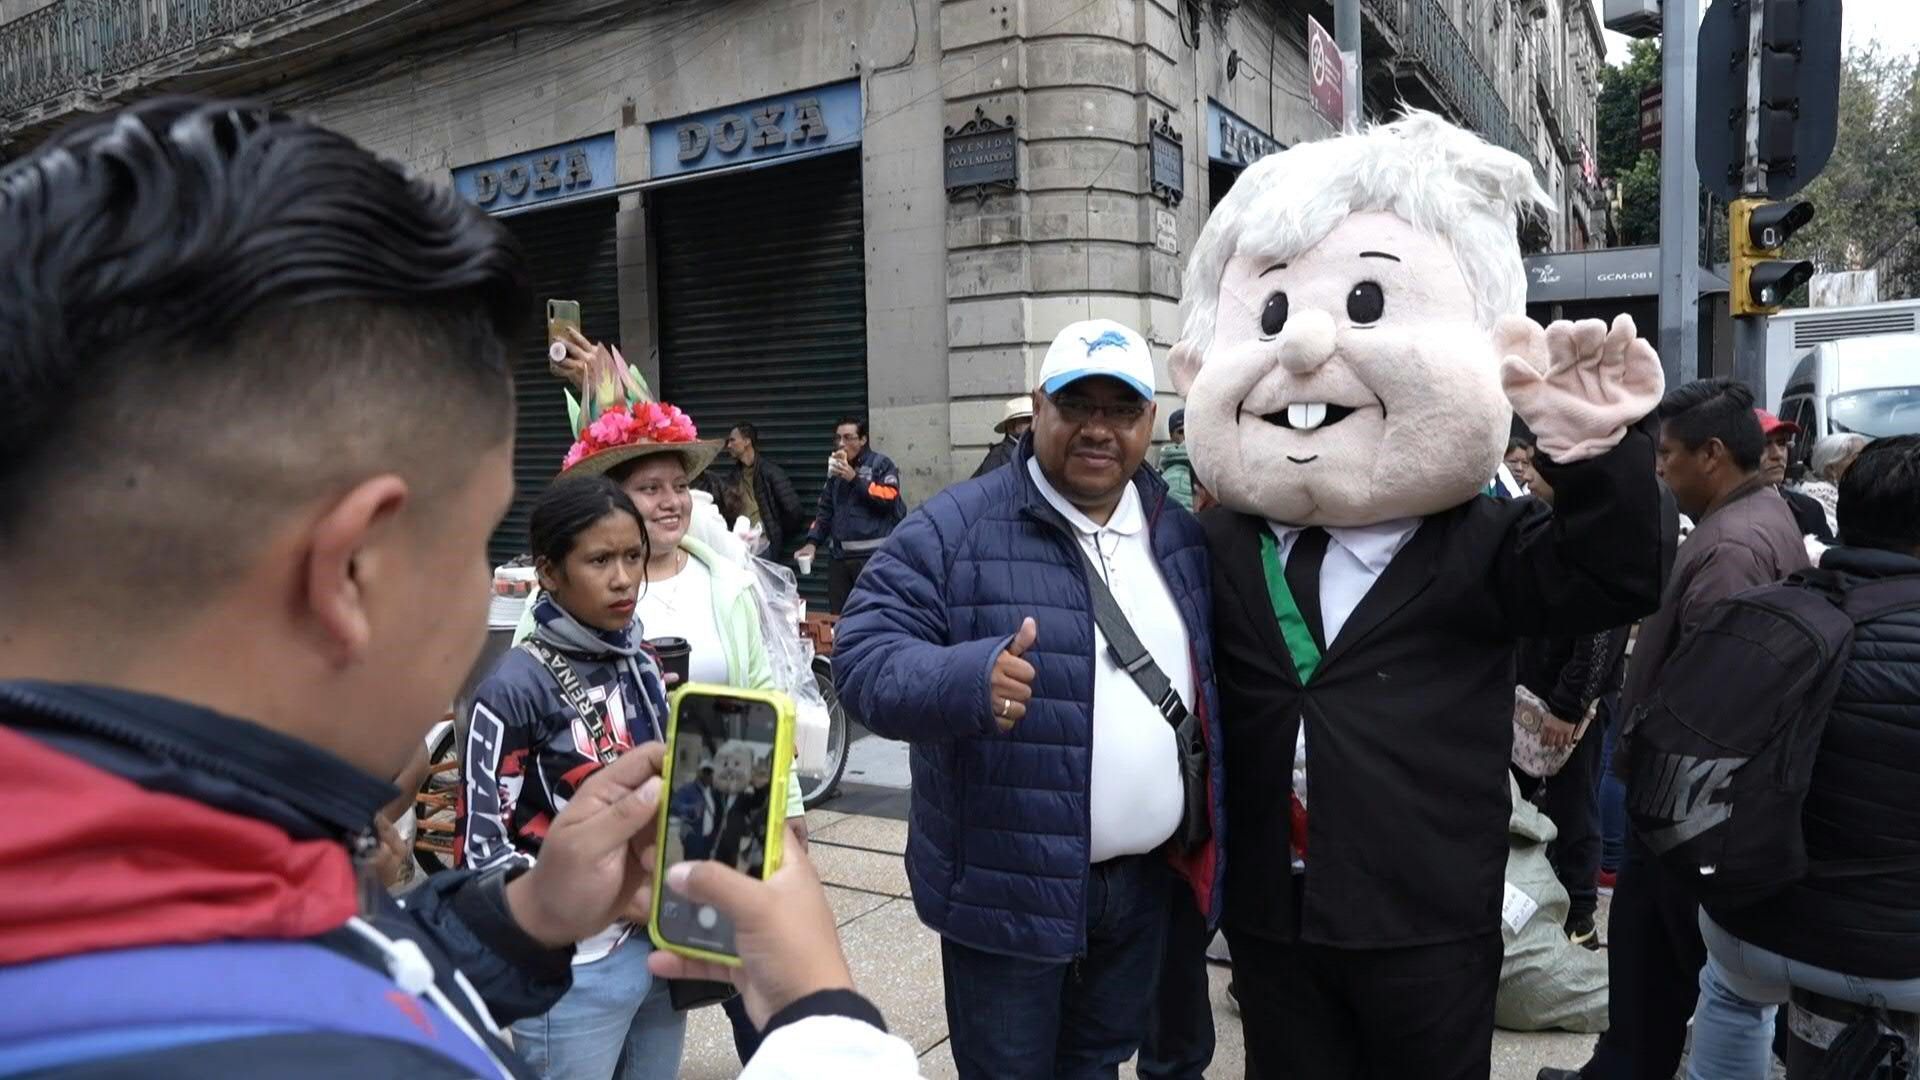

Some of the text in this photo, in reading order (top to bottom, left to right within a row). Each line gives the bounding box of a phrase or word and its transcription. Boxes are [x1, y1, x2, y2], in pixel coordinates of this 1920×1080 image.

[676, 98, 829, 164] DOXA
[950, 138, 1012, 153] AVENIDA
[475, 149, 592, 206] DOXA
[1597, 271, 1654, 281] GCM-081
[550, 654, 594, 716] REINA
